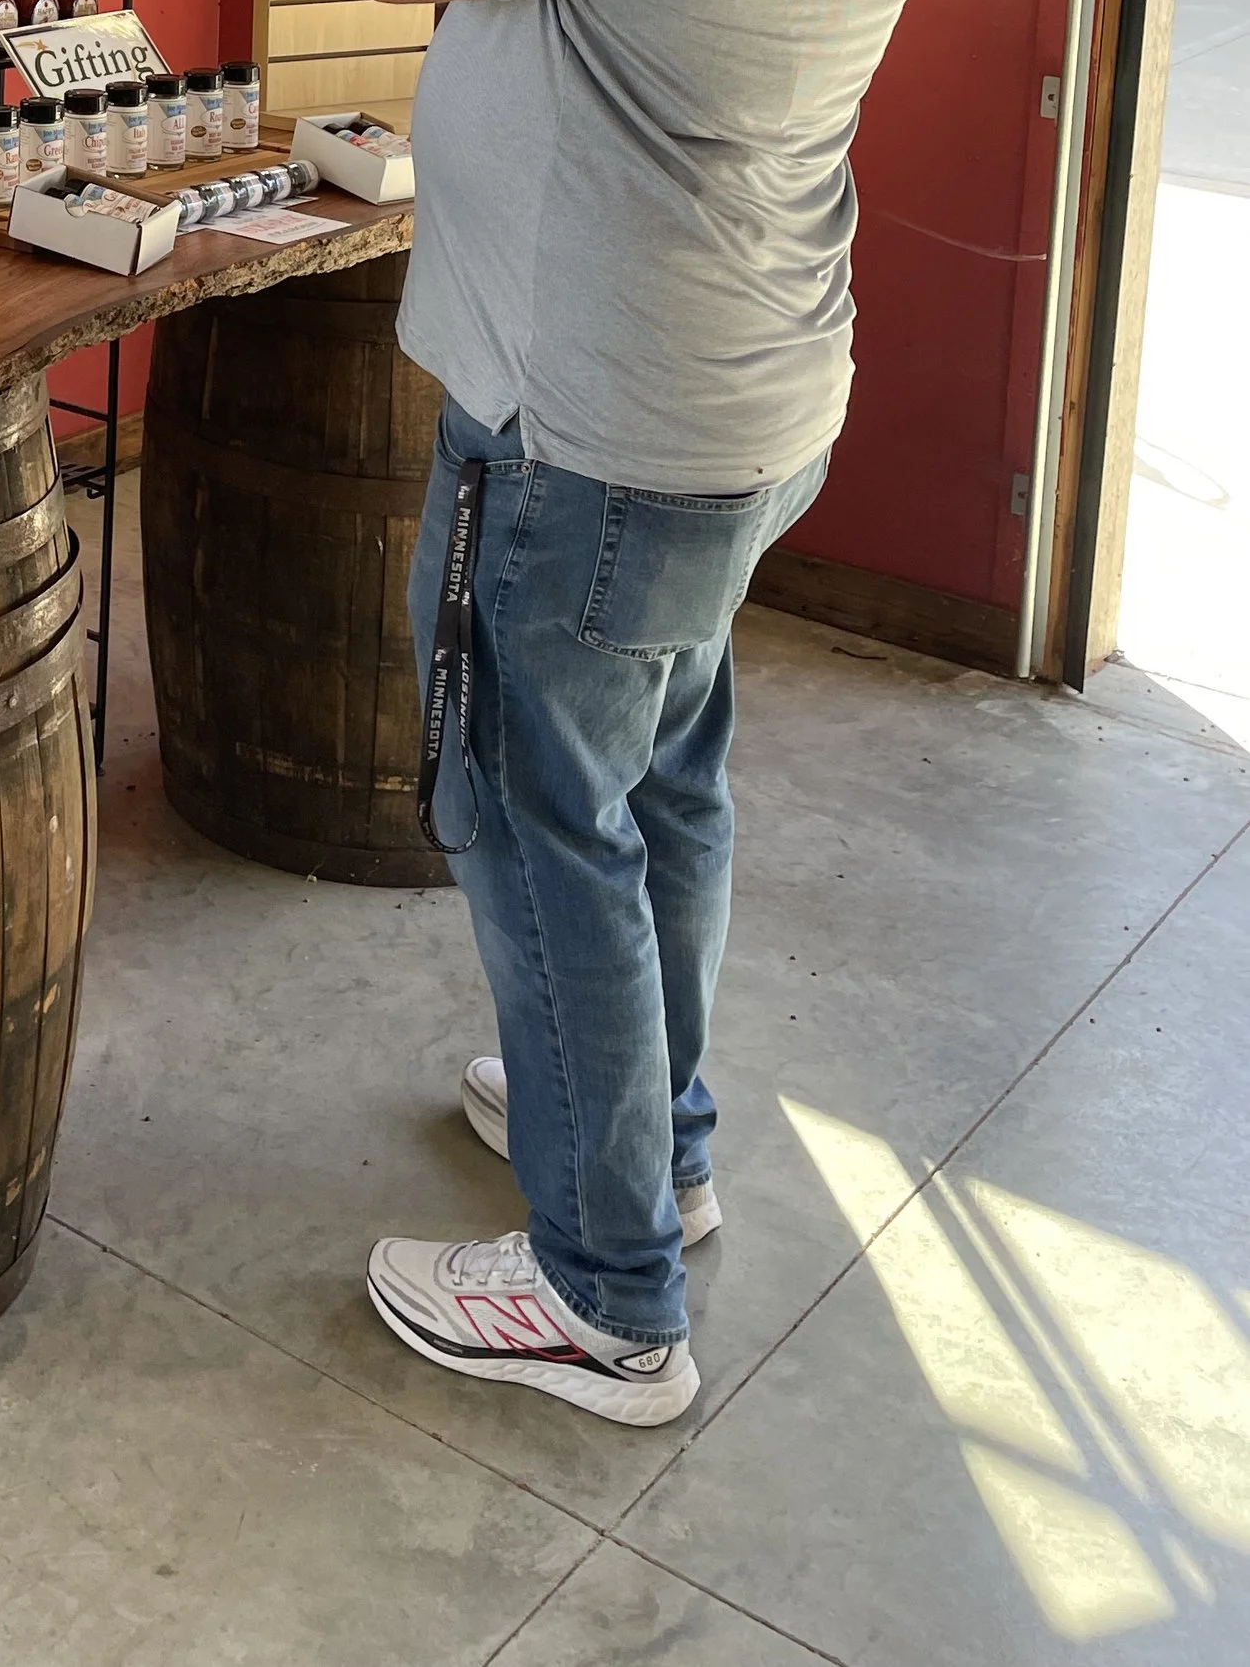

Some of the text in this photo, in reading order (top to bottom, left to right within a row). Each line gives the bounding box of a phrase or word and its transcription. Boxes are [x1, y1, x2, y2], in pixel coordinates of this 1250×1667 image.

[34, 40, 154, 87] Gifting
[447, 507, 471, 602] MINNESOTA
[427, 668, 448, 761] MINNESOTA
[639, 1352, 660, 1368] 680
